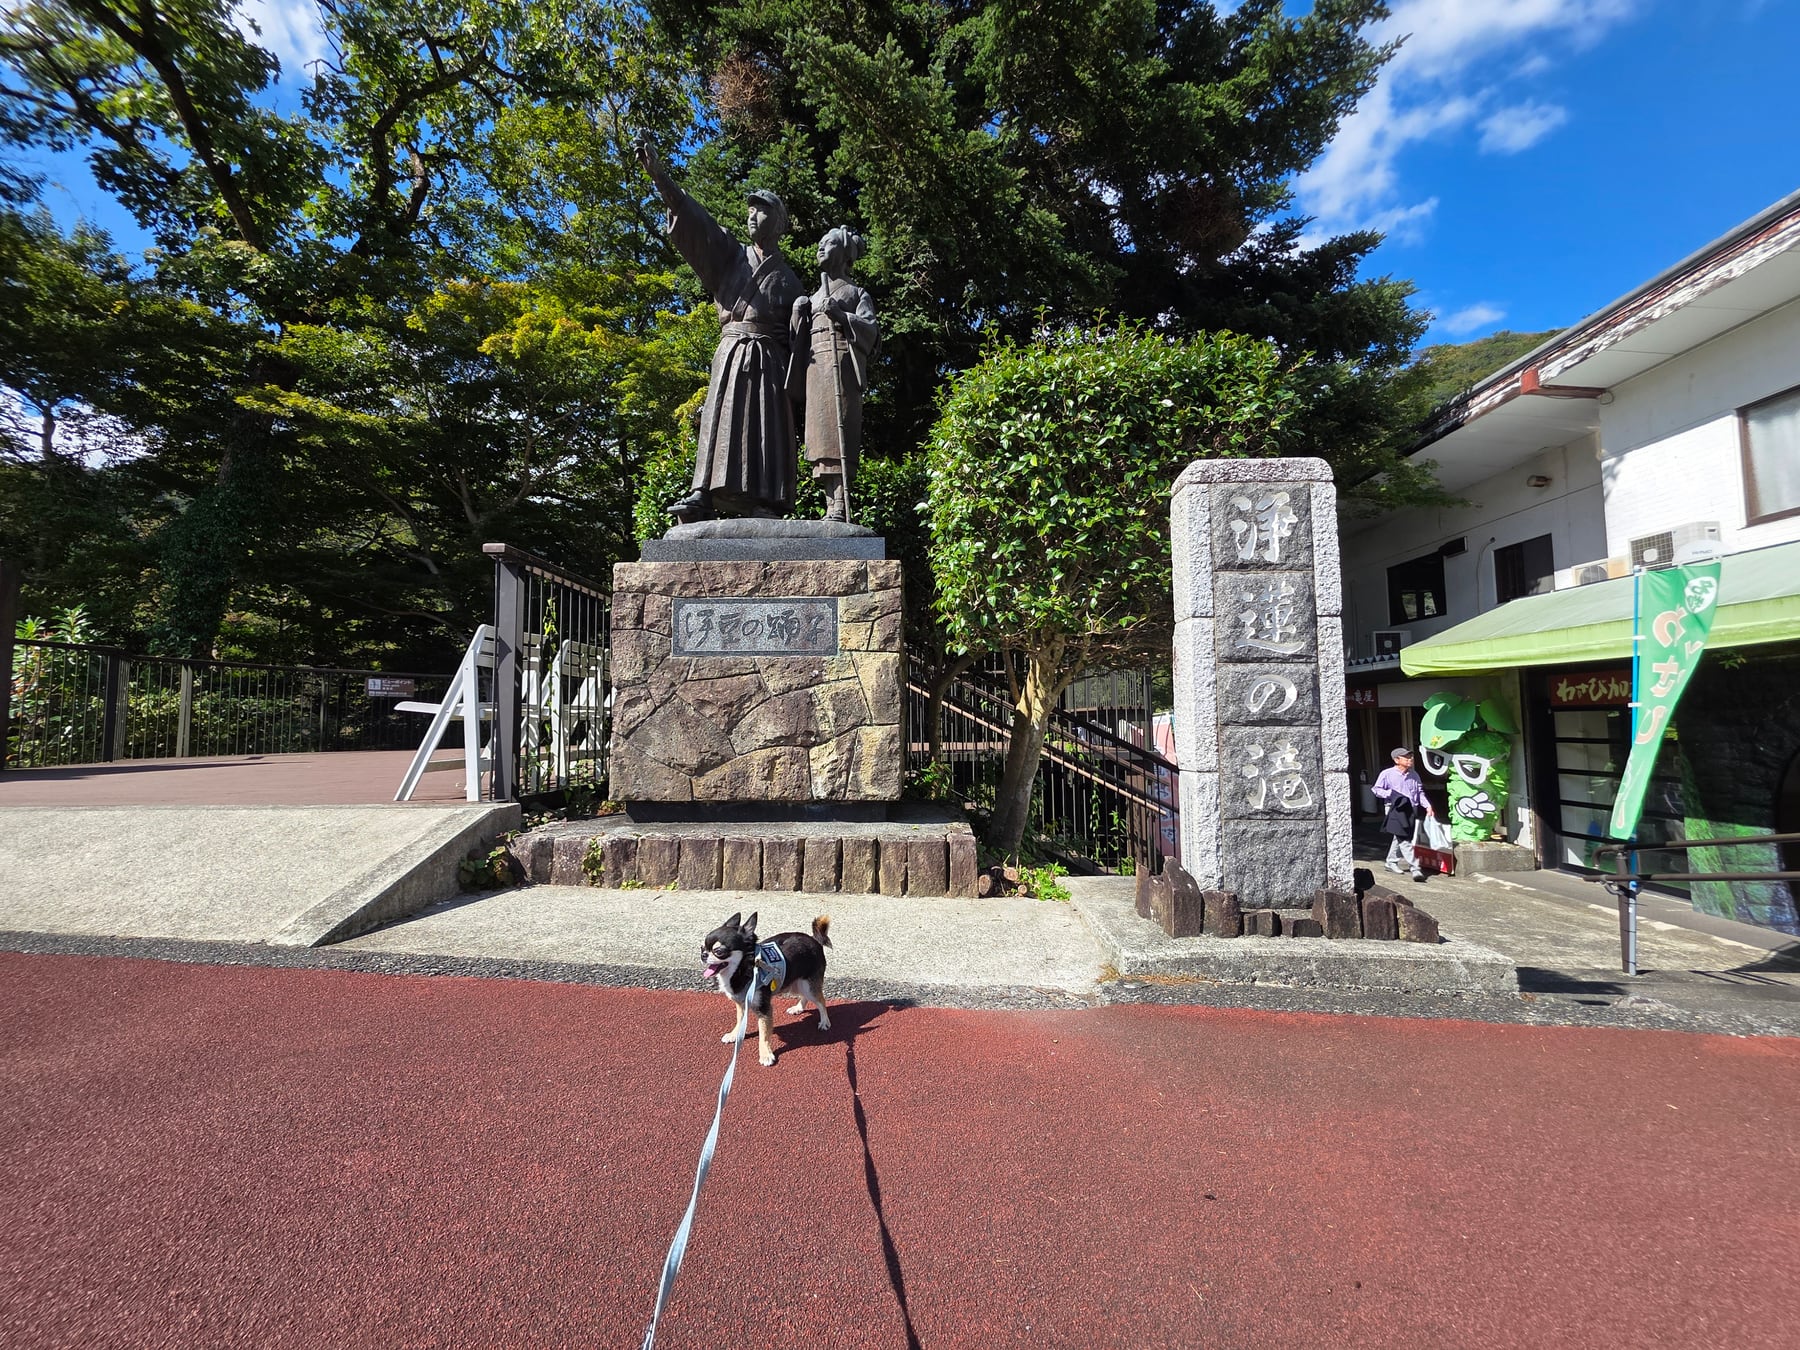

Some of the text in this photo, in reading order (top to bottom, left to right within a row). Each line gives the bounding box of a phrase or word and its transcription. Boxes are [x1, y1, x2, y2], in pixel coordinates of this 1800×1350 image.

[685, 608, 826, 648] 伊豆の踊子
[1230, 490, 1313, 810] 浄蓮の滝
[1556, 676, 1633, 702] わさび加
